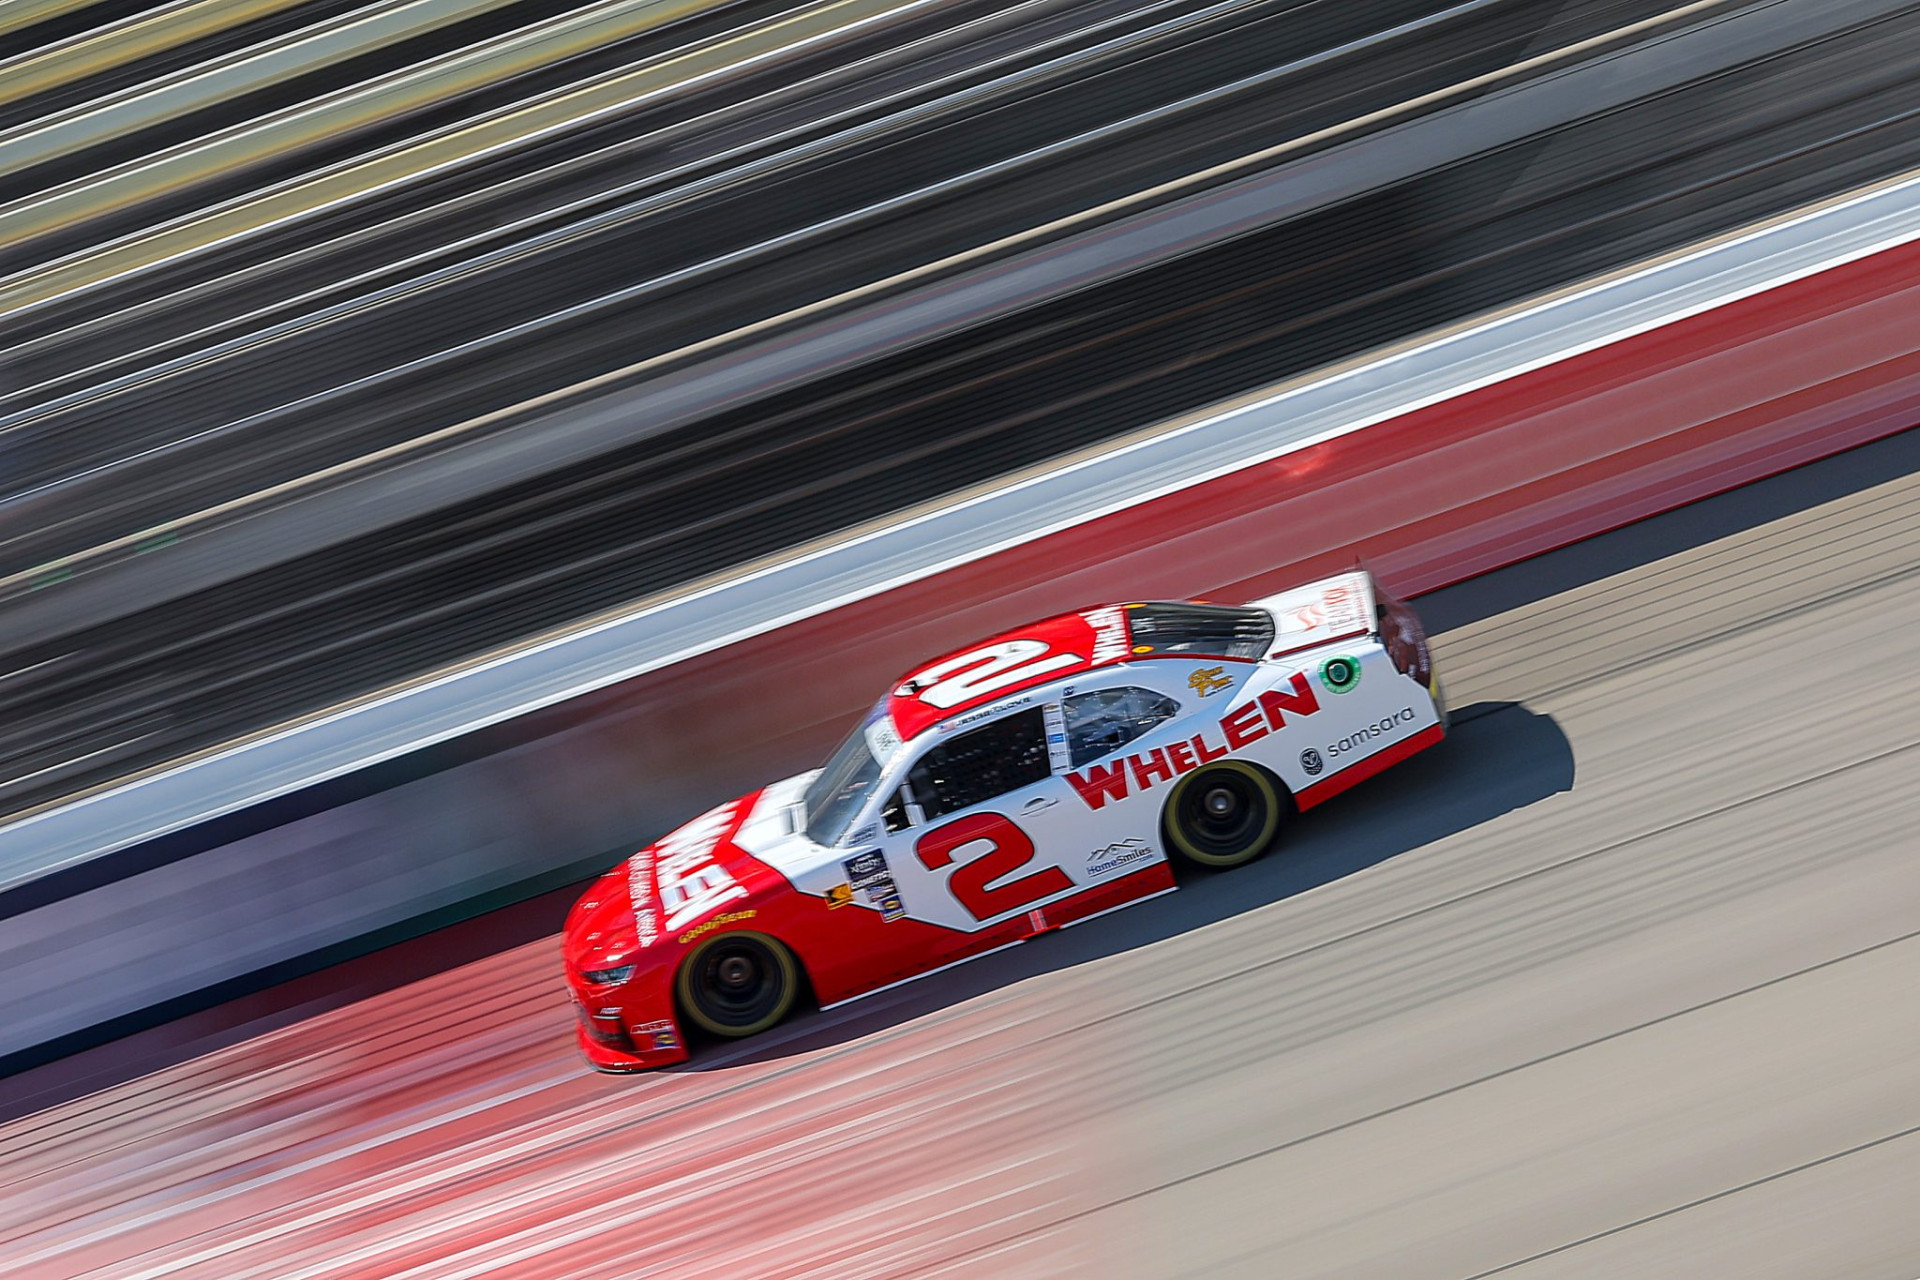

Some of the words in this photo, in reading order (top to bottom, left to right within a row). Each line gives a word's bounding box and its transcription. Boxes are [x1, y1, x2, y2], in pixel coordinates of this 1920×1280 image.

[1078, 606, 1128, 666] WHELEN
[893, 638, 1085, 709] 2
[1064, 671, 1321, 812] WHELEN
[1327, 706, 1416, 759] samsara
[915, 811, 1076, 923] 2
[1087, 845, 1153, 877] HomeSmiles
